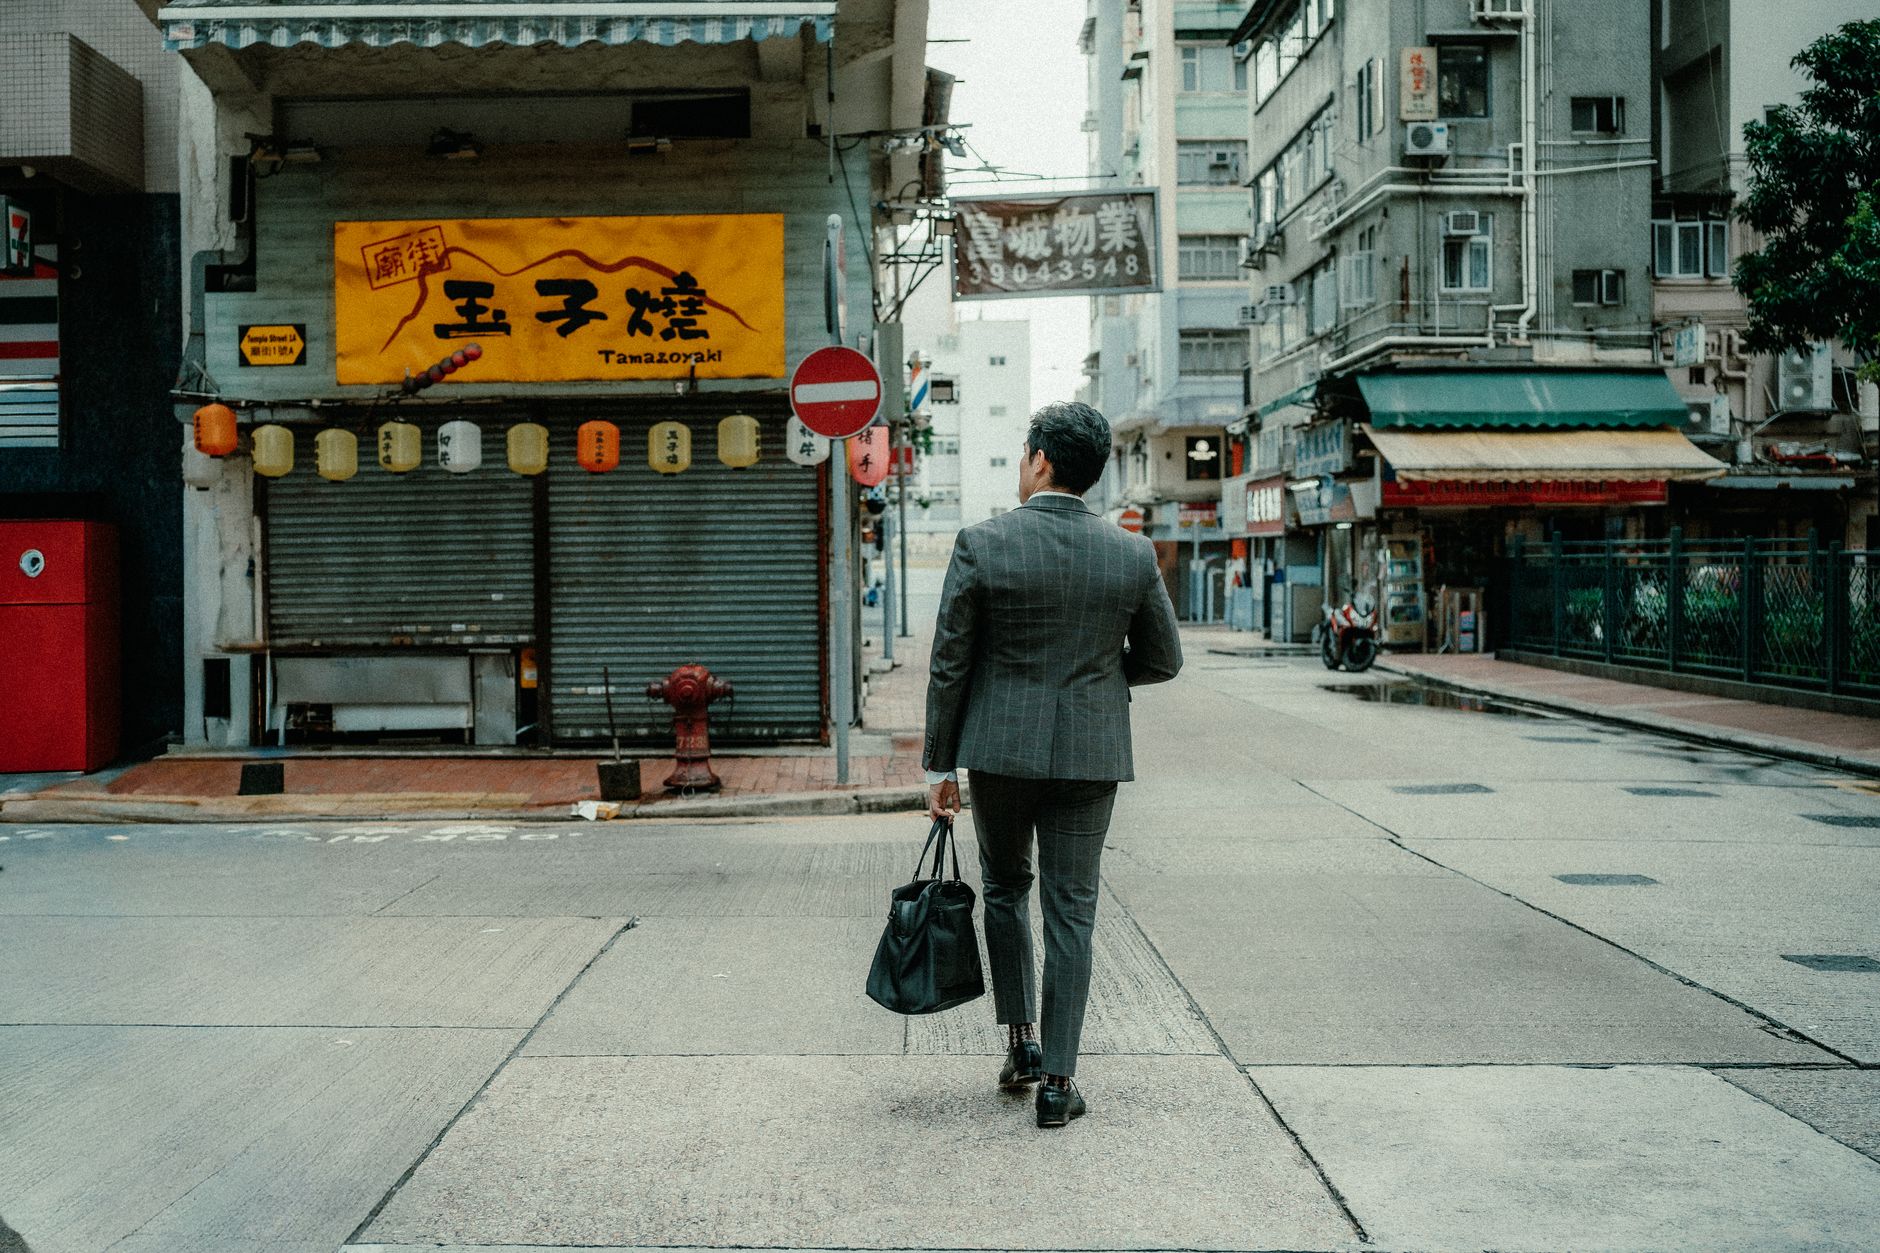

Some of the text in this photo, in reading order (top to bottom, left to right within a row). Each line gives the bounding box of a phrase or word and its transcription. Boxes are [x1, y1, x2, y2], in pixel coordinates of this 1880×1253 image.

[969, 254, 1139, 286] 39043548
[434, 272, 709, 341] 玉子燒
